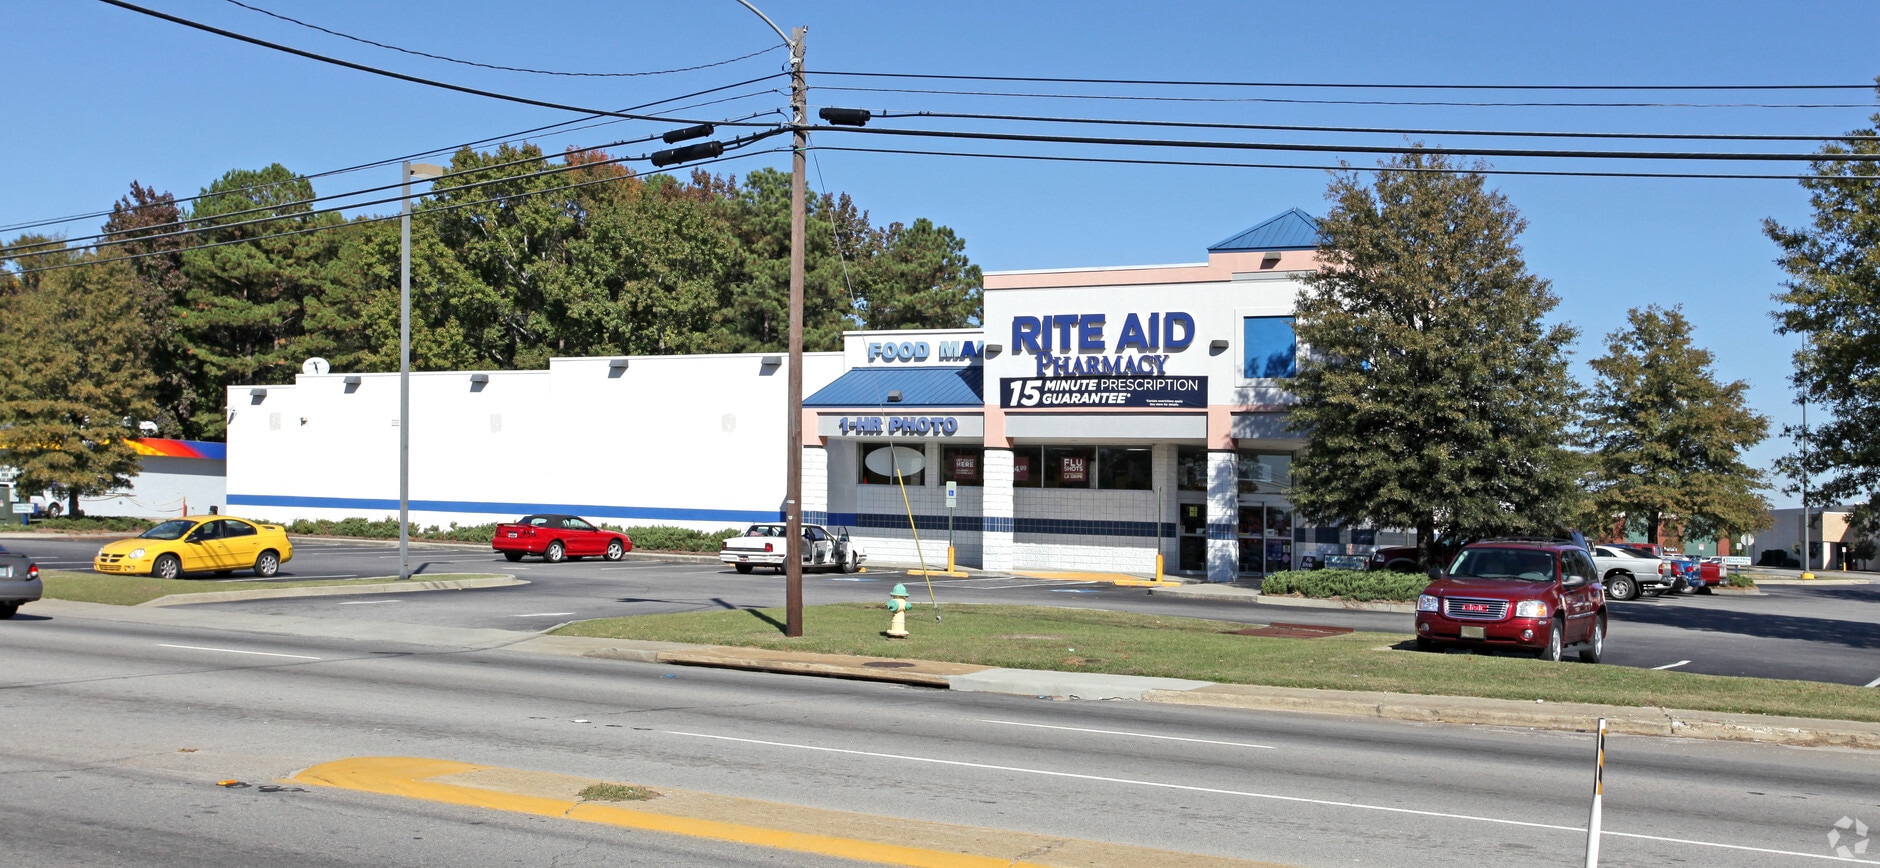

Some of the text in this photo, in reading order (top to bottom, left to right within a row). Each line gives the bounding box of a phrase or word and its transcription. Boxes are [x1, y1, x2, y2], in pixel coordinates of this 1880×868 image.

[1012, 312, 1196, 354] RITE AID
[868, 342, 930, 361] FOOD
[1035, 351, 1169, 376] PHARMACY
[1010, 380, 1043, 406] 15
[1044, 379, 1199, 391] MINUTE PRESCRIPTION
[839, 417, 959, 436] 1-HR PHOTO
[1064, 458, 1083, 466] FLU
[1462, 603, 1489, 612] GMC
